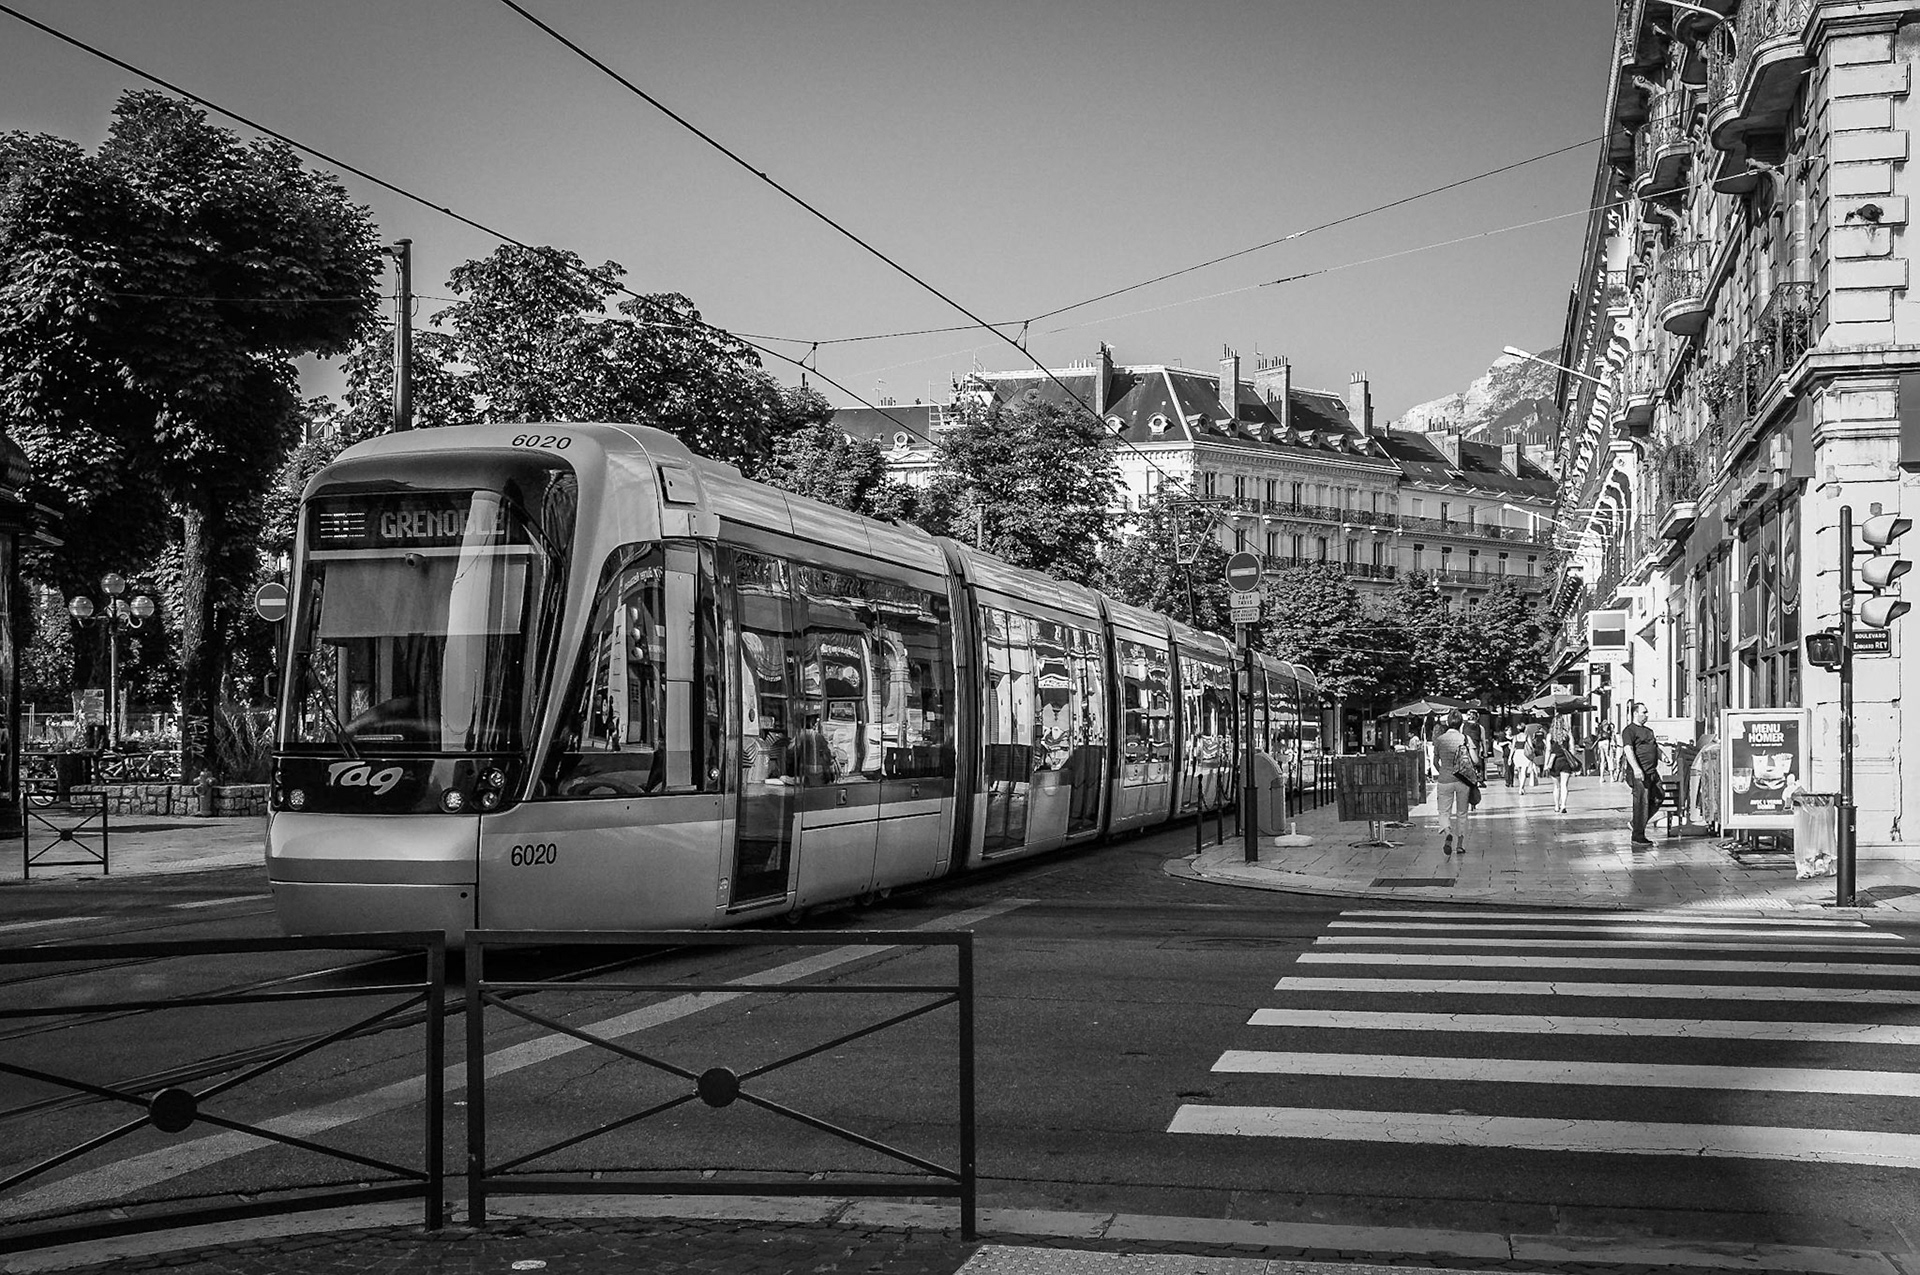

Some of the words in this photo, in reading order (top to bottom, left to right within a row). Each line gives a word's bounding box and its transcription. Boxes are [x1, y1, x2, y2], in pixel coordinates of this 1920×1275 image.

[512, 434, 572, 450] 6020
[1875, 641, 1888, 649] REY
[1751, 723, 1781, 733] MENU
[1748, 732, 1785, 743] HOMER
[511, 843, 557, 866] 6020
